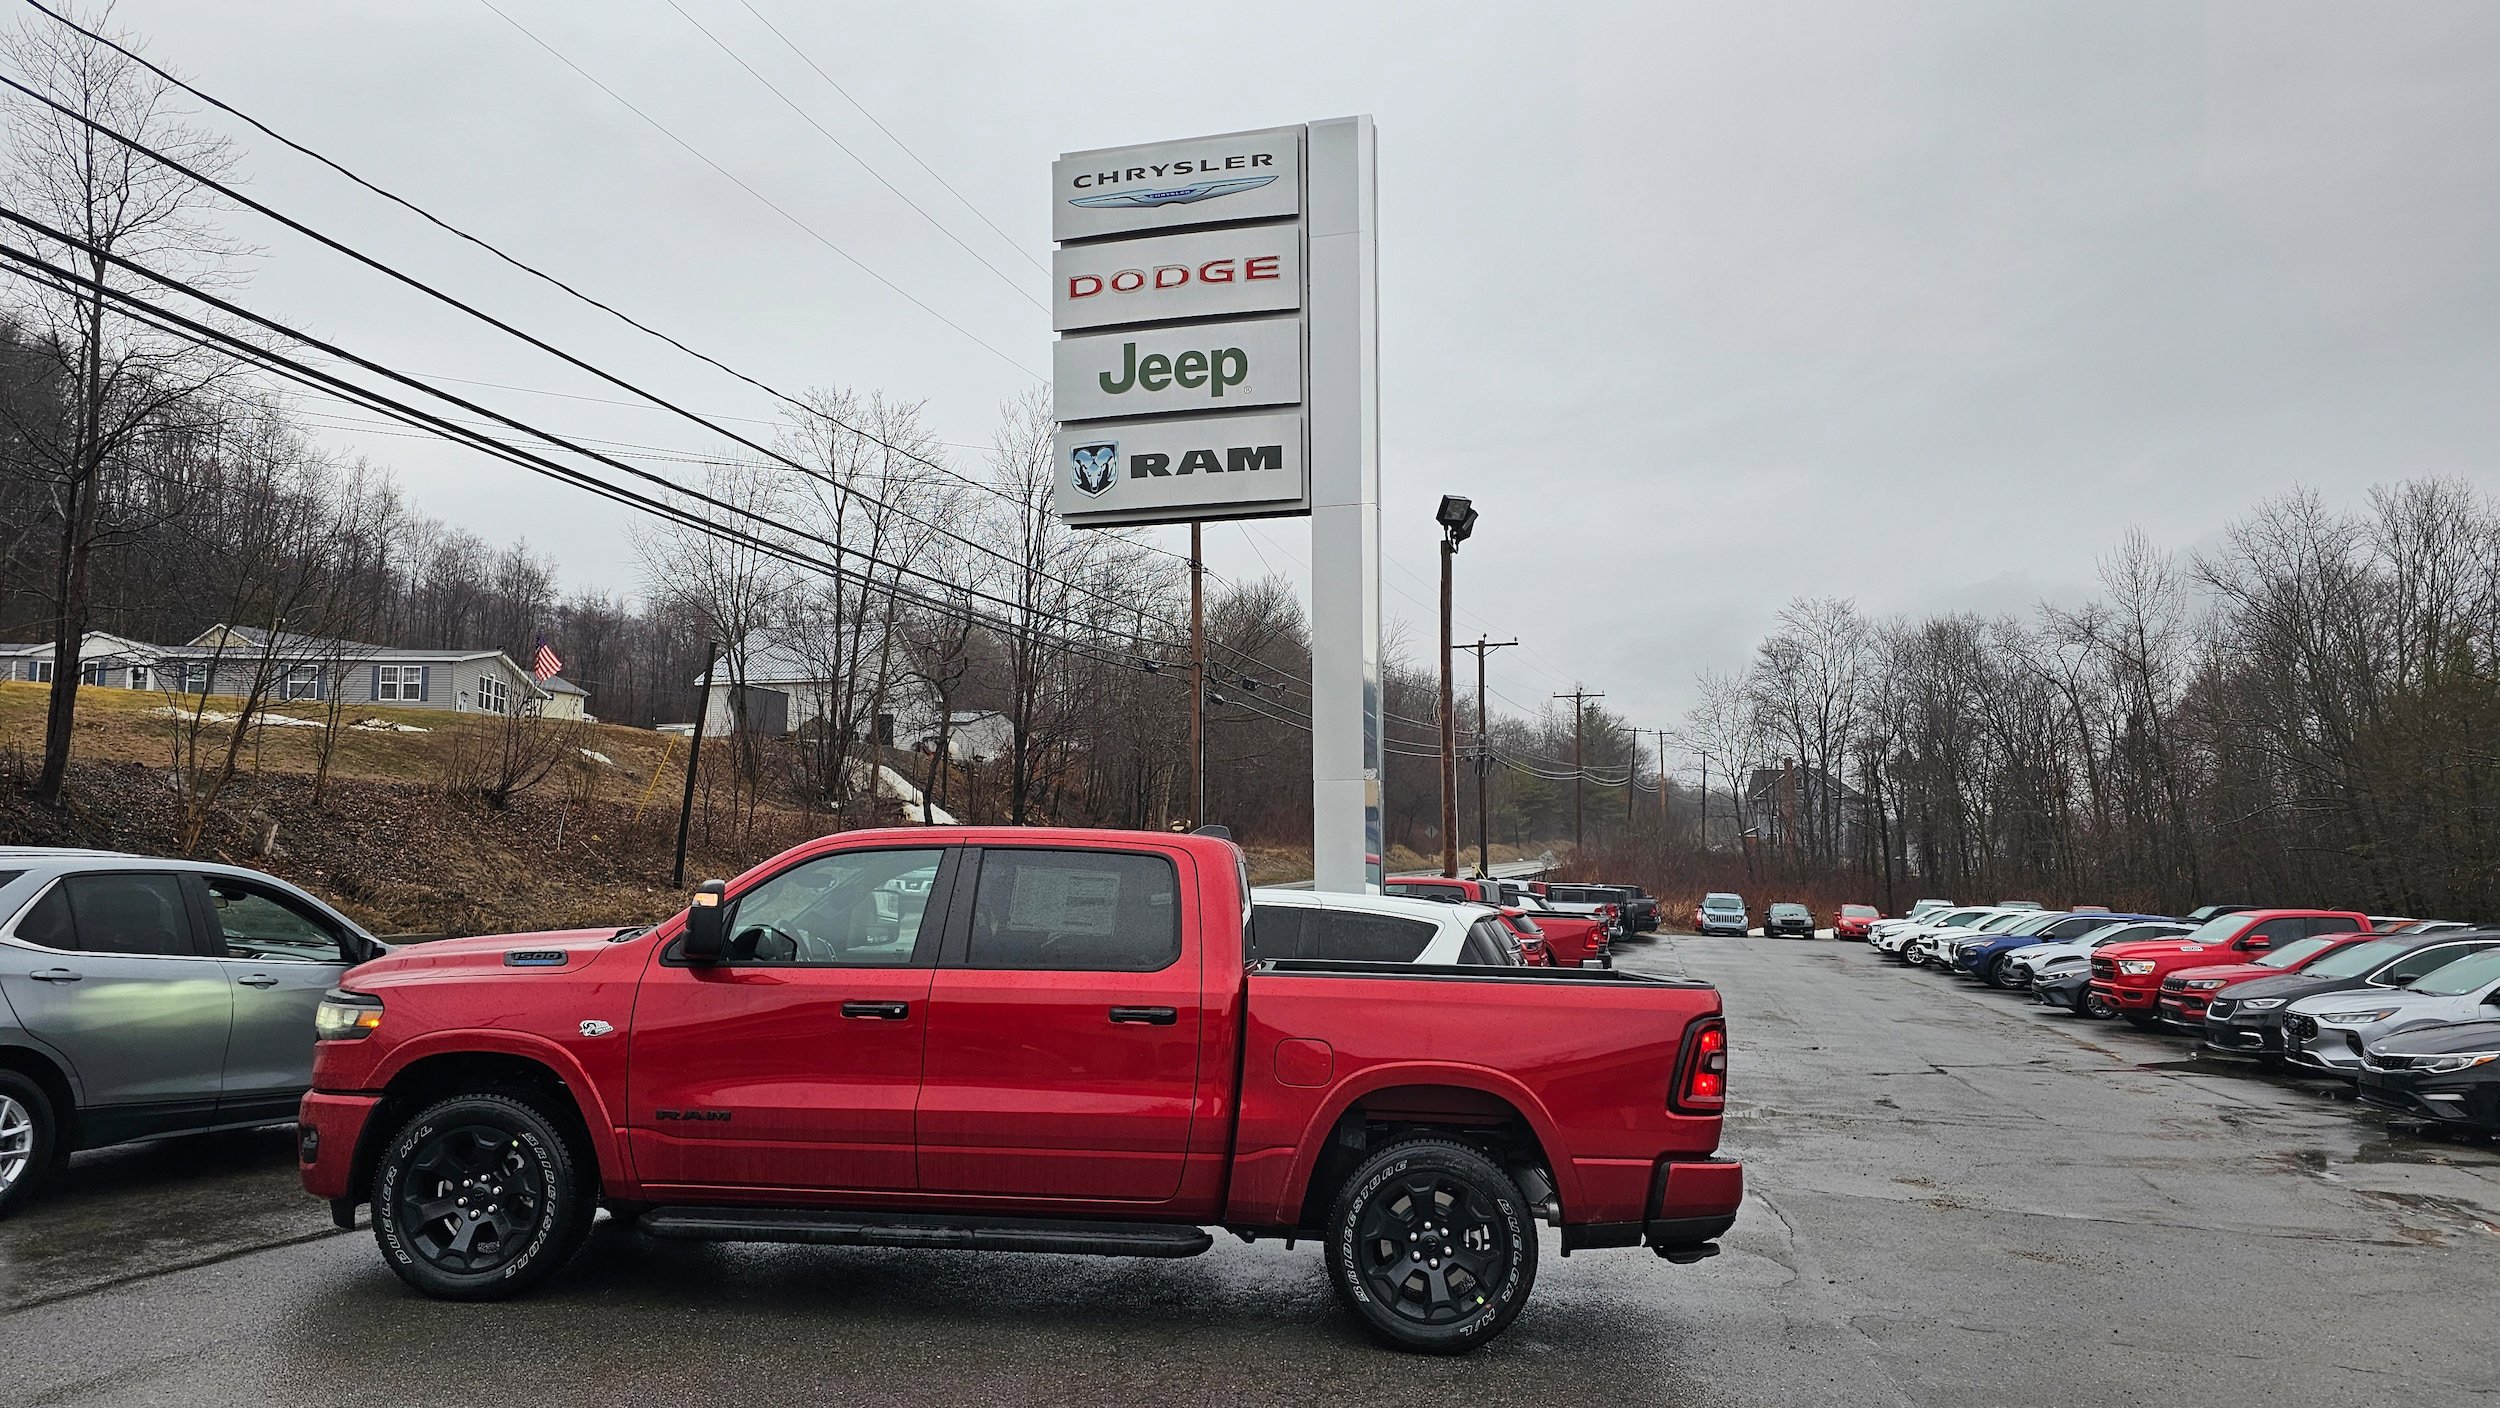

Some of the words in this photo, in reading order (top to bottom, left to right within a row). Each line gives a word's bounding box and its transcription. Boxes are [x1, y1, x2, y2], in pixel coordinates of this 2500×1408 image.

[1073, 153, 1273, 188] CHRYSLER
[1150, 189, 1191, 198] CHRYSLER
[1068, 255, 1281, 300] DODGE
[1099, 342, 1248, 397] Jeep
[1130, 445, 1282, 479] RAM
[513, 952, 560, 960] 1500
[656, 1109, 731, 1121] RAM
[505, 1132, 556, 1278] BRIDGESTONE
[1342, 1159, 1408, 1303] BRIDGESTONE
